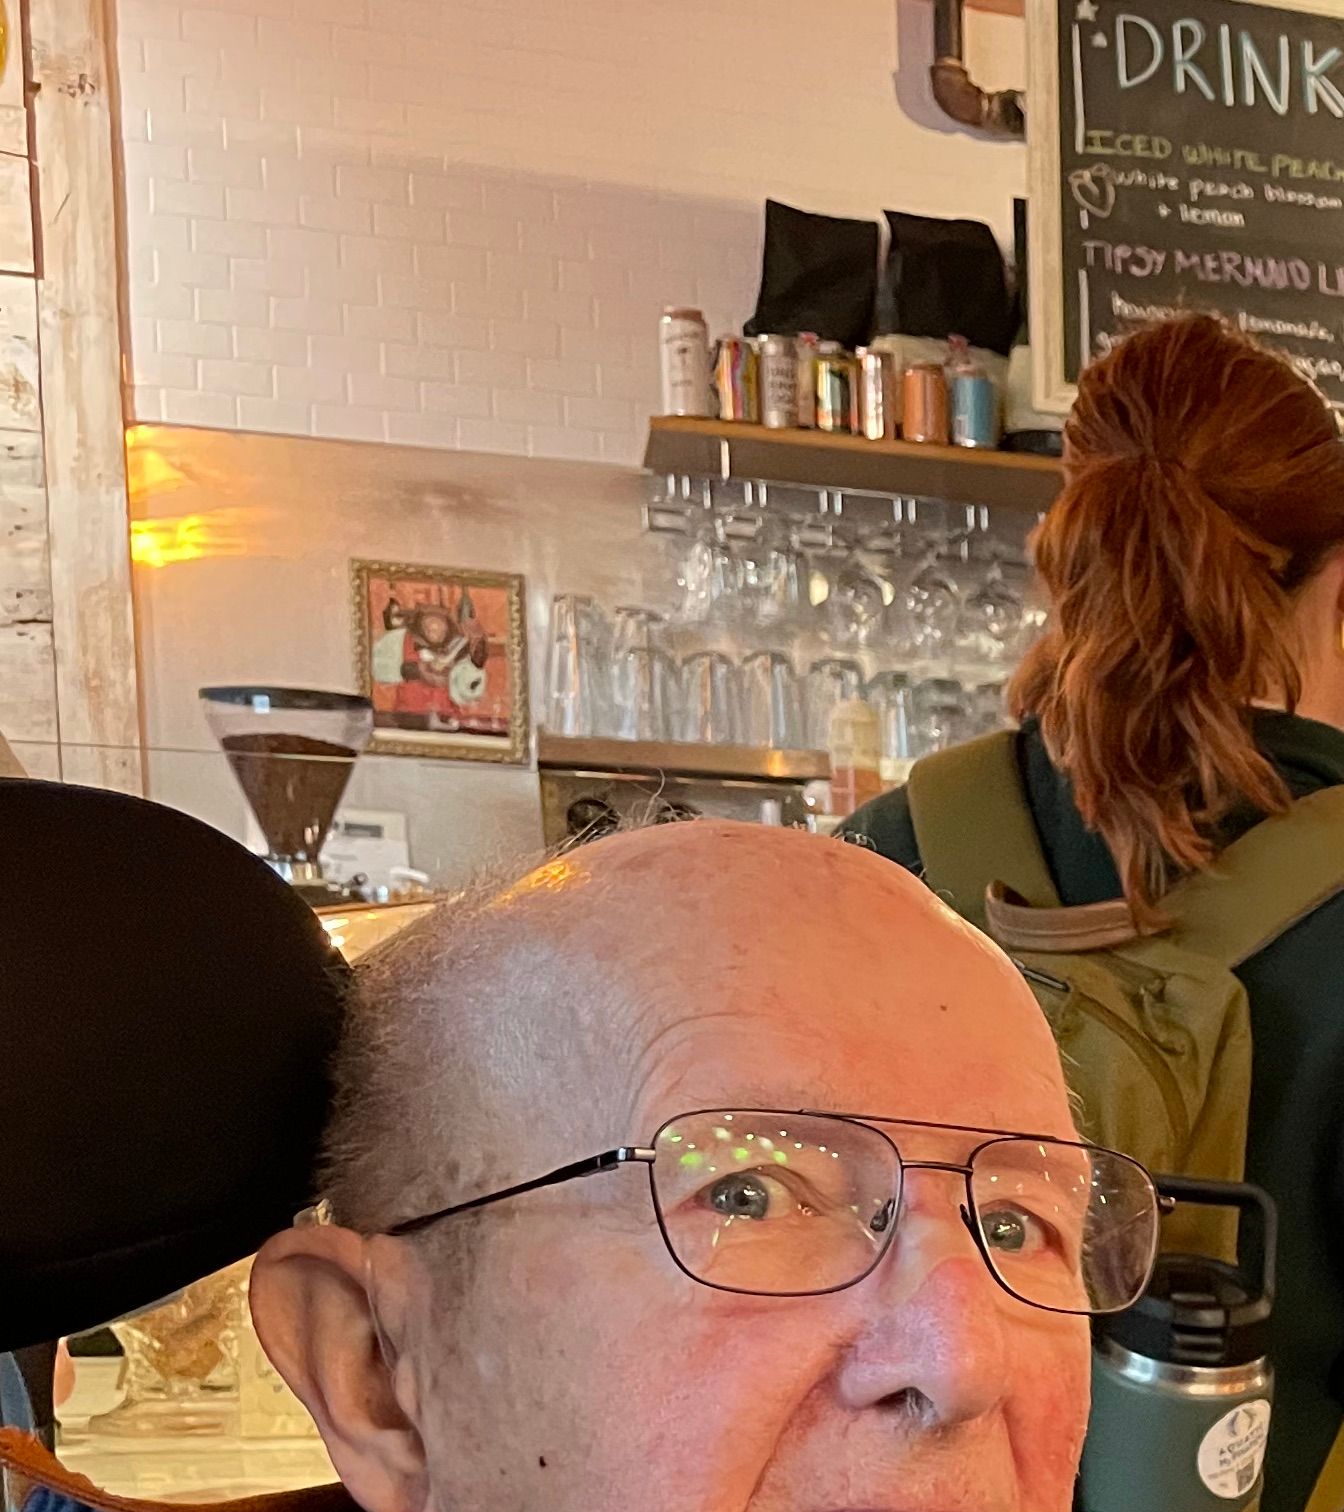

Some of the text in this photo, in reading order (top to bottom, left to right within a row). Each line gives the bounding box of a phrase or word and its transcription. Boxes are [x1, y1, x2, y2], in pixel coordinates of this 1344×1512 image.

[1085, 130, 1172, 159] ICED
[1182, 143, 1268, 172] WHITE
[1114, 167, 1180, 191] white
[1189, 179, 1255, 202] peach
[1263, 182, 1344, 209] blossom
[1178, 203, 1246, 228] lemon
[1081, 240, 1168, 277] TIPSY
[1174, 249, 1312, 291] MERMAID
